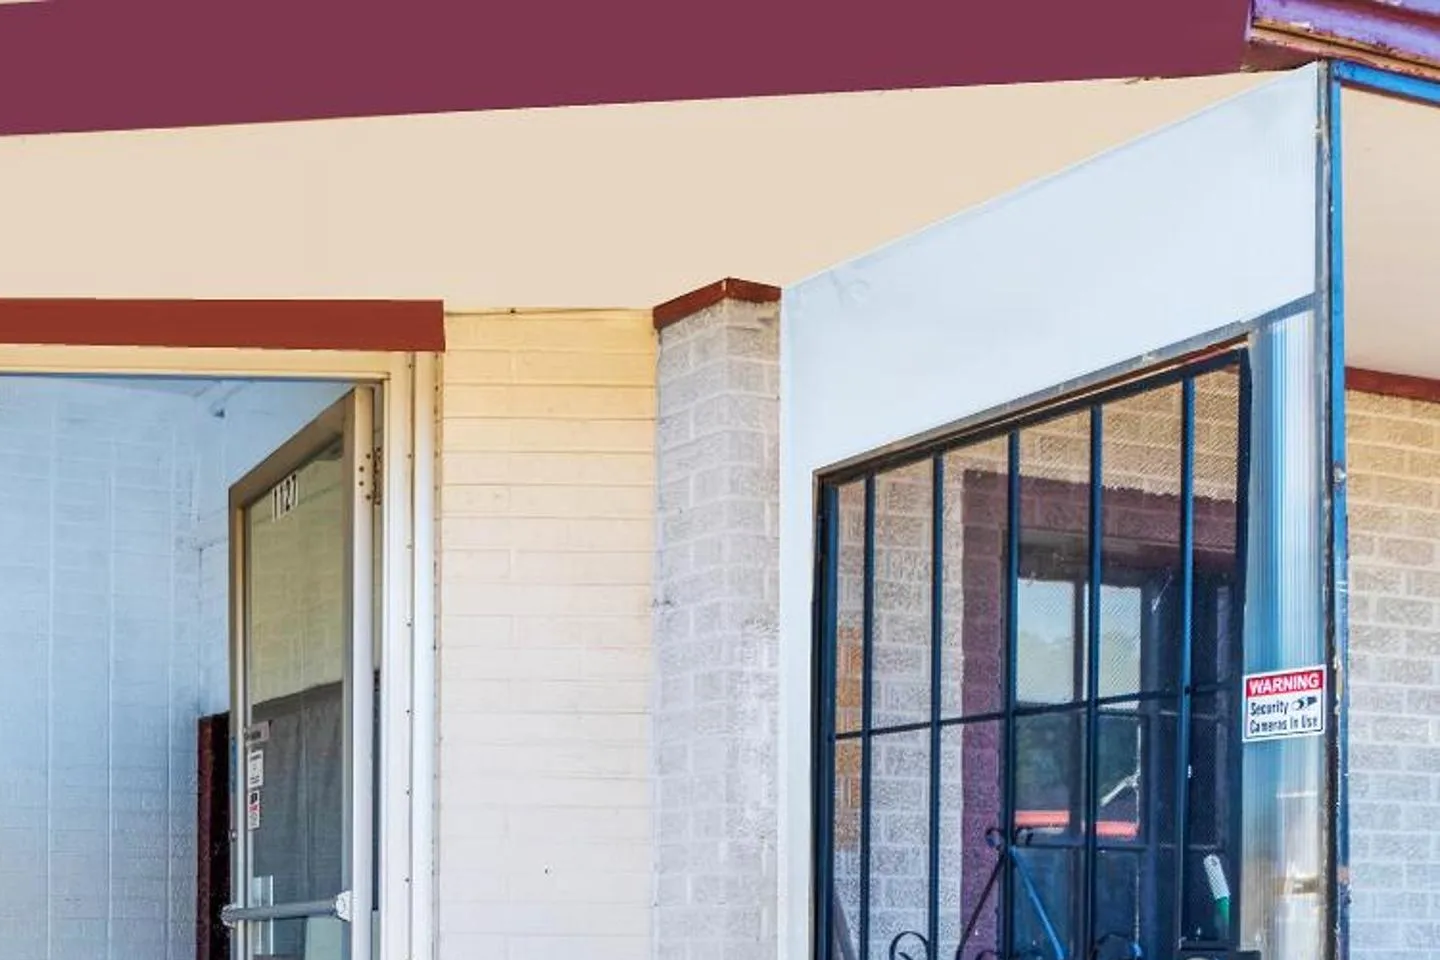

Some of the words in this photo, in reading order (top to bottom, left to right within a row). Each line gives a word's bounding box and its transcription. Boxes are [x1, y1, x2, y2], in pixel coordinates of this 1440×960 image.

[271, 472, 299, 522] 1127
[1248, 673, 1320, 696] WARNING
[1250, 700, 1289, 716] Security
[1249, 719, 1288, 734] Cameras
[1301, 714, 1318, 728] Use
